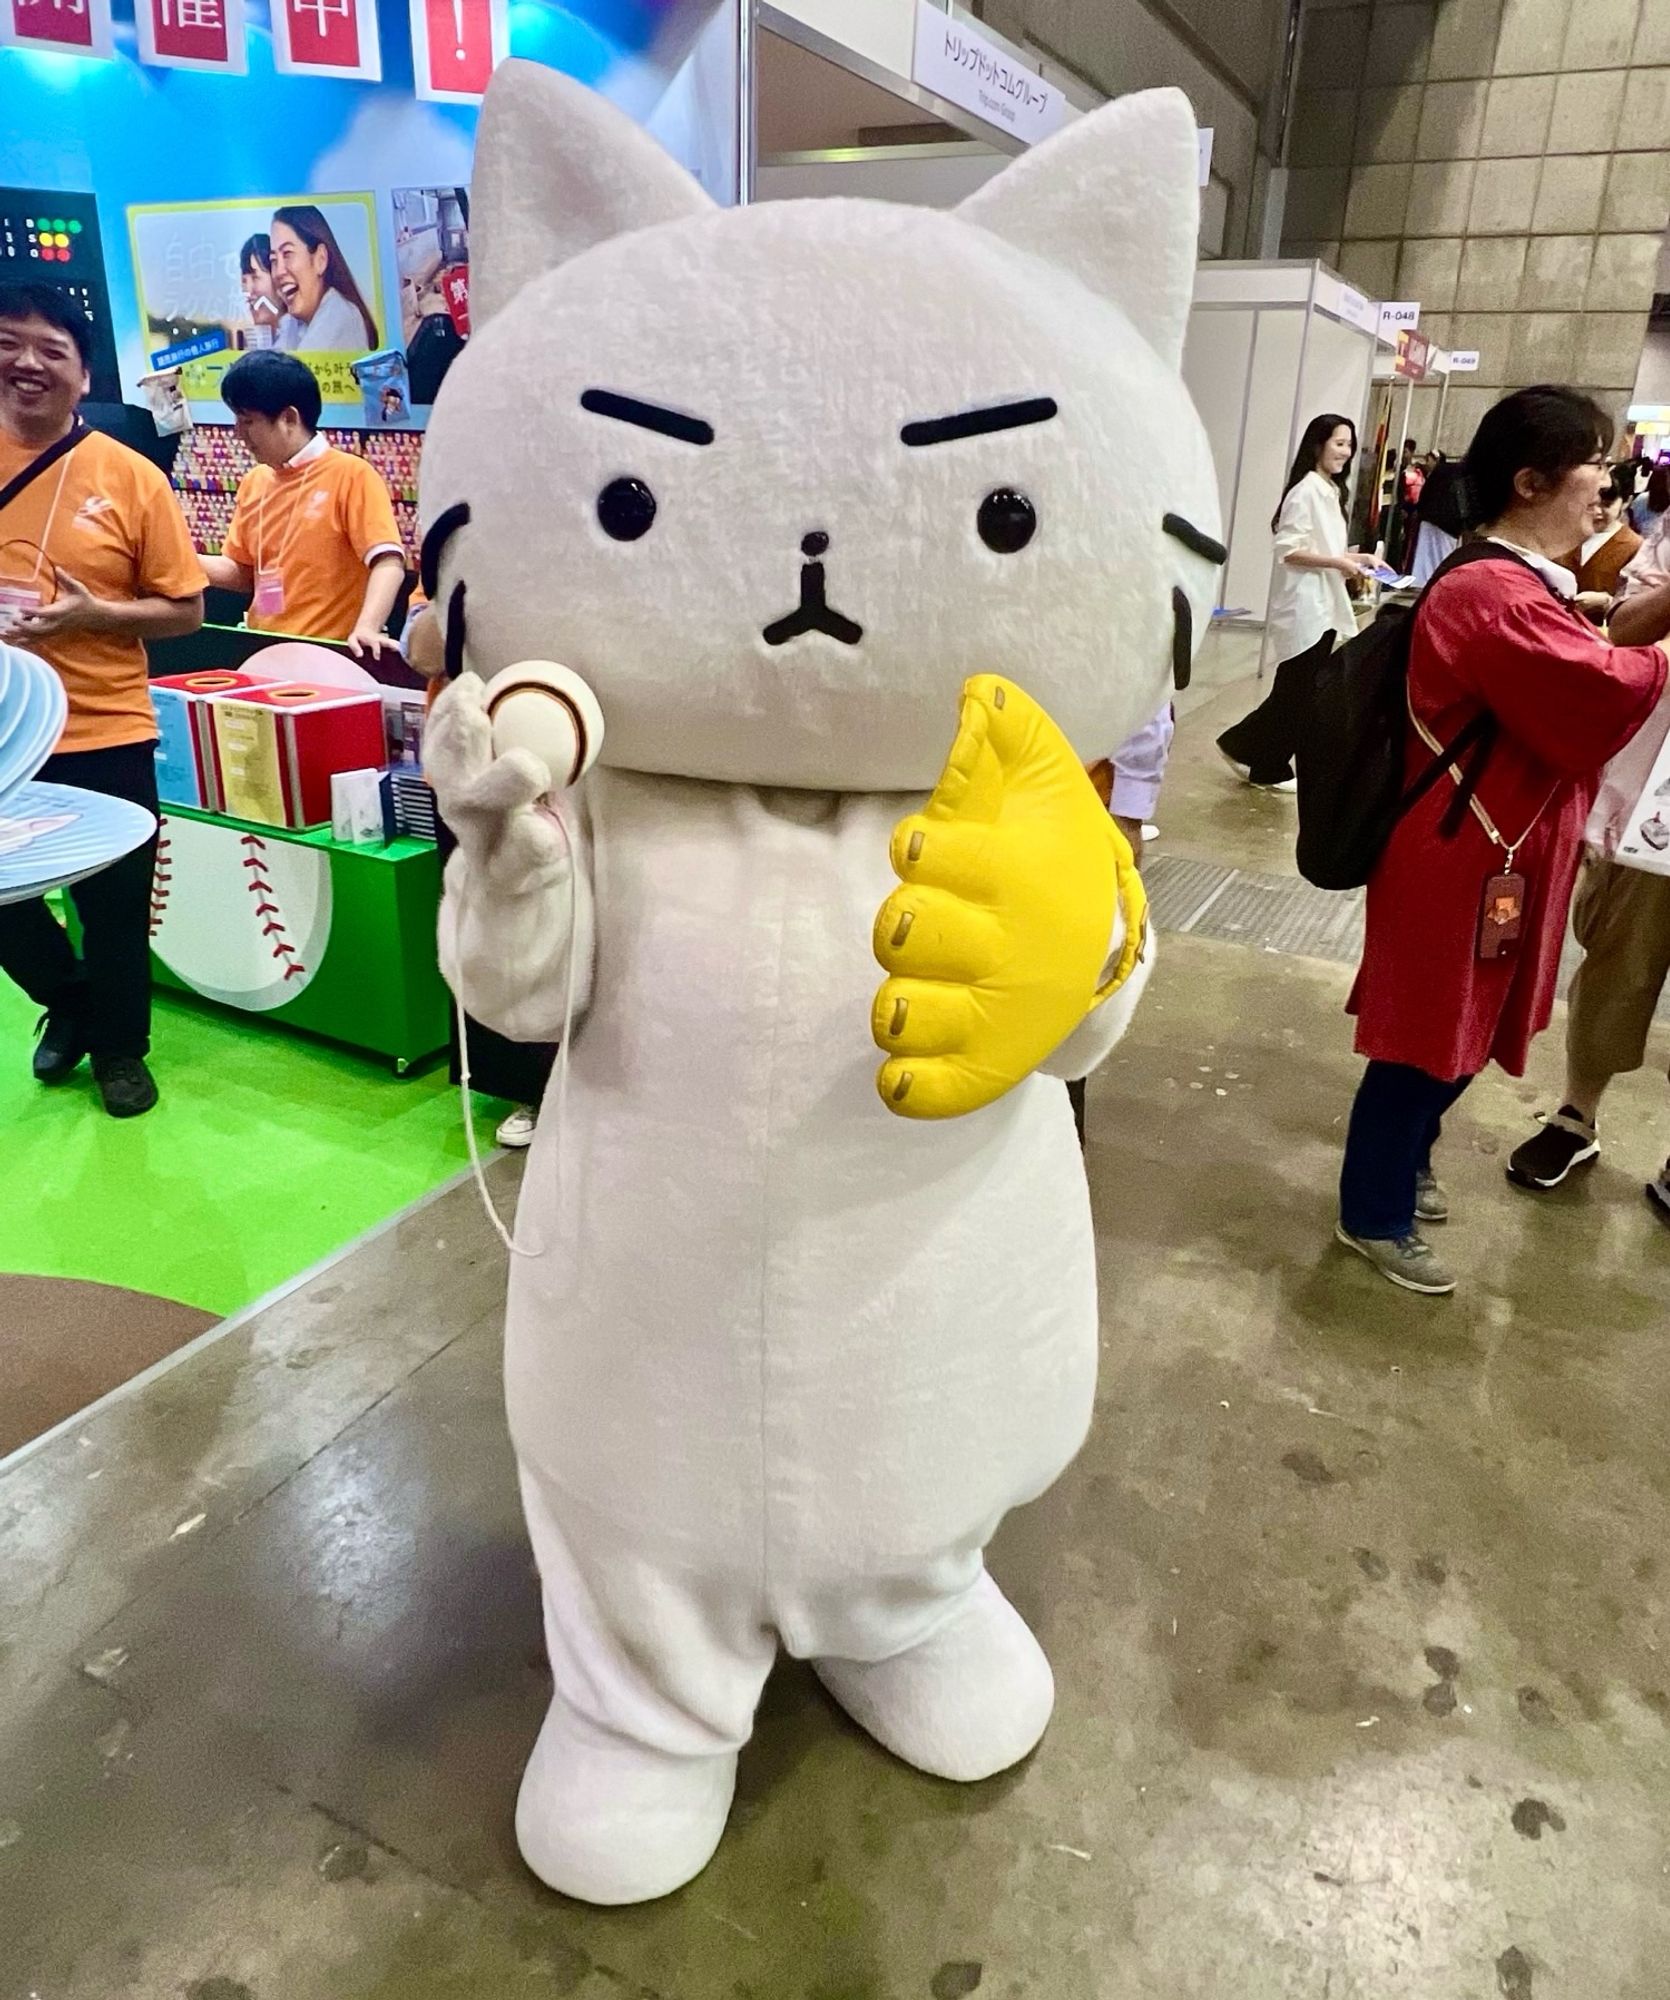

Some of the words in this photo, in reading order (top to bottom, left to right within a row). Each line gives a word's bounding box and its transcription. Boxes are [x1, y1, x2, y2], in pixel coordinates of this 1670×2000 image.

[943, 29, 1049, 114] トリップドットコムグループ
[1382, 311, 1416, 321] R-048
